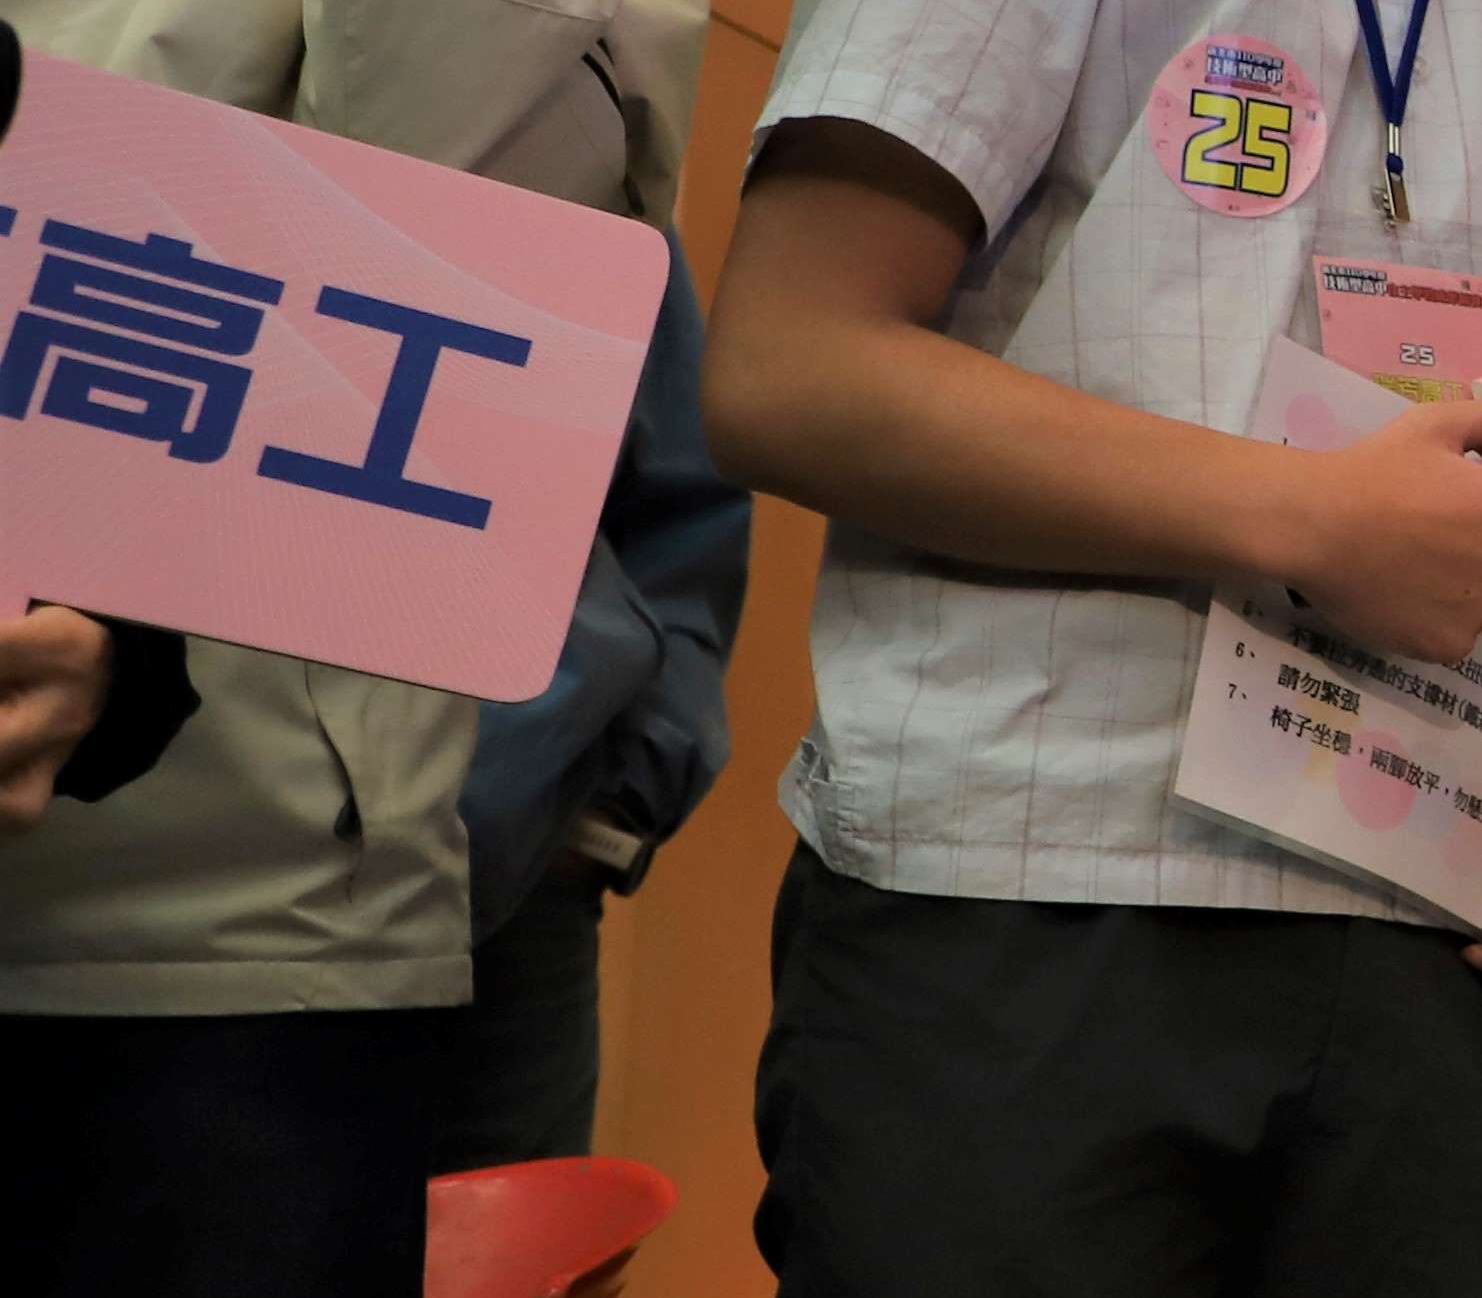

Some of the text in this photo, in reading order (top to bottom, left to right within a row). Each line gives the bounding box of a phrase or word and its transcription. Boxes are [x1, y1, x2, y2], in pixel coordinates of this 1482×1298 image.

[1181, 88, 1293, 198] 25
[0, 208, 533, 531] 高工
[1399, 342, 1435, 367] 25
